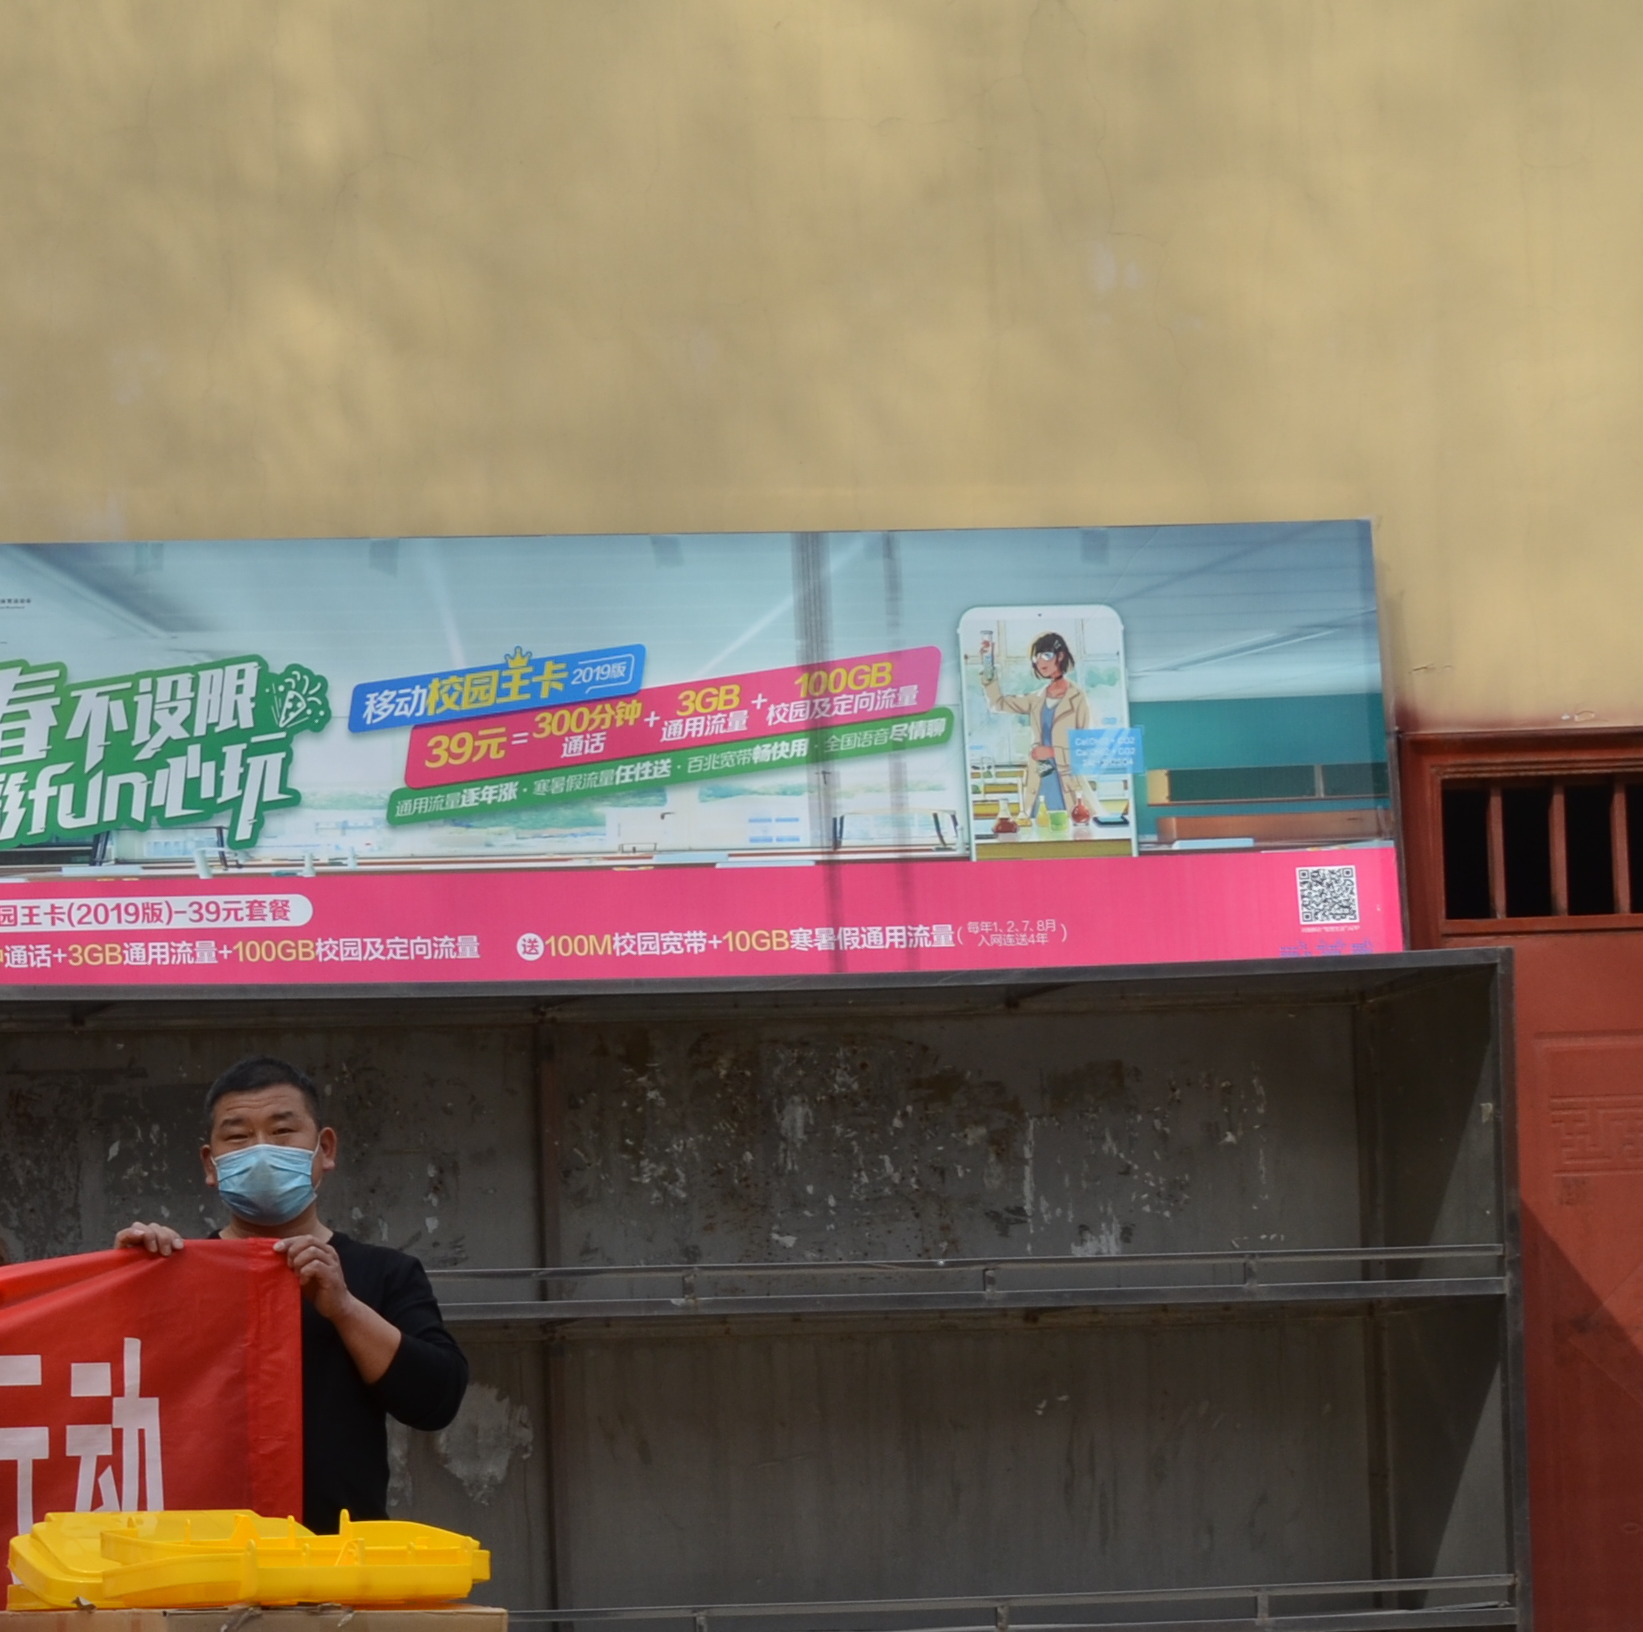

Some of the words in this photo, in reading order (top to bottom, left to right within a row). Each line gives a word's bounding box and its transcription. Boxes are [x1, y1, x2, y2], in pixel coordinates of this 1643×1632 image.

[363, 660, 569, 725] 移动校园王卡
[560, 731, 607, 759] 通话
[660, 709, 748, 742] 通用流量
[766, 685, 920, 726] 校园及定向流量
